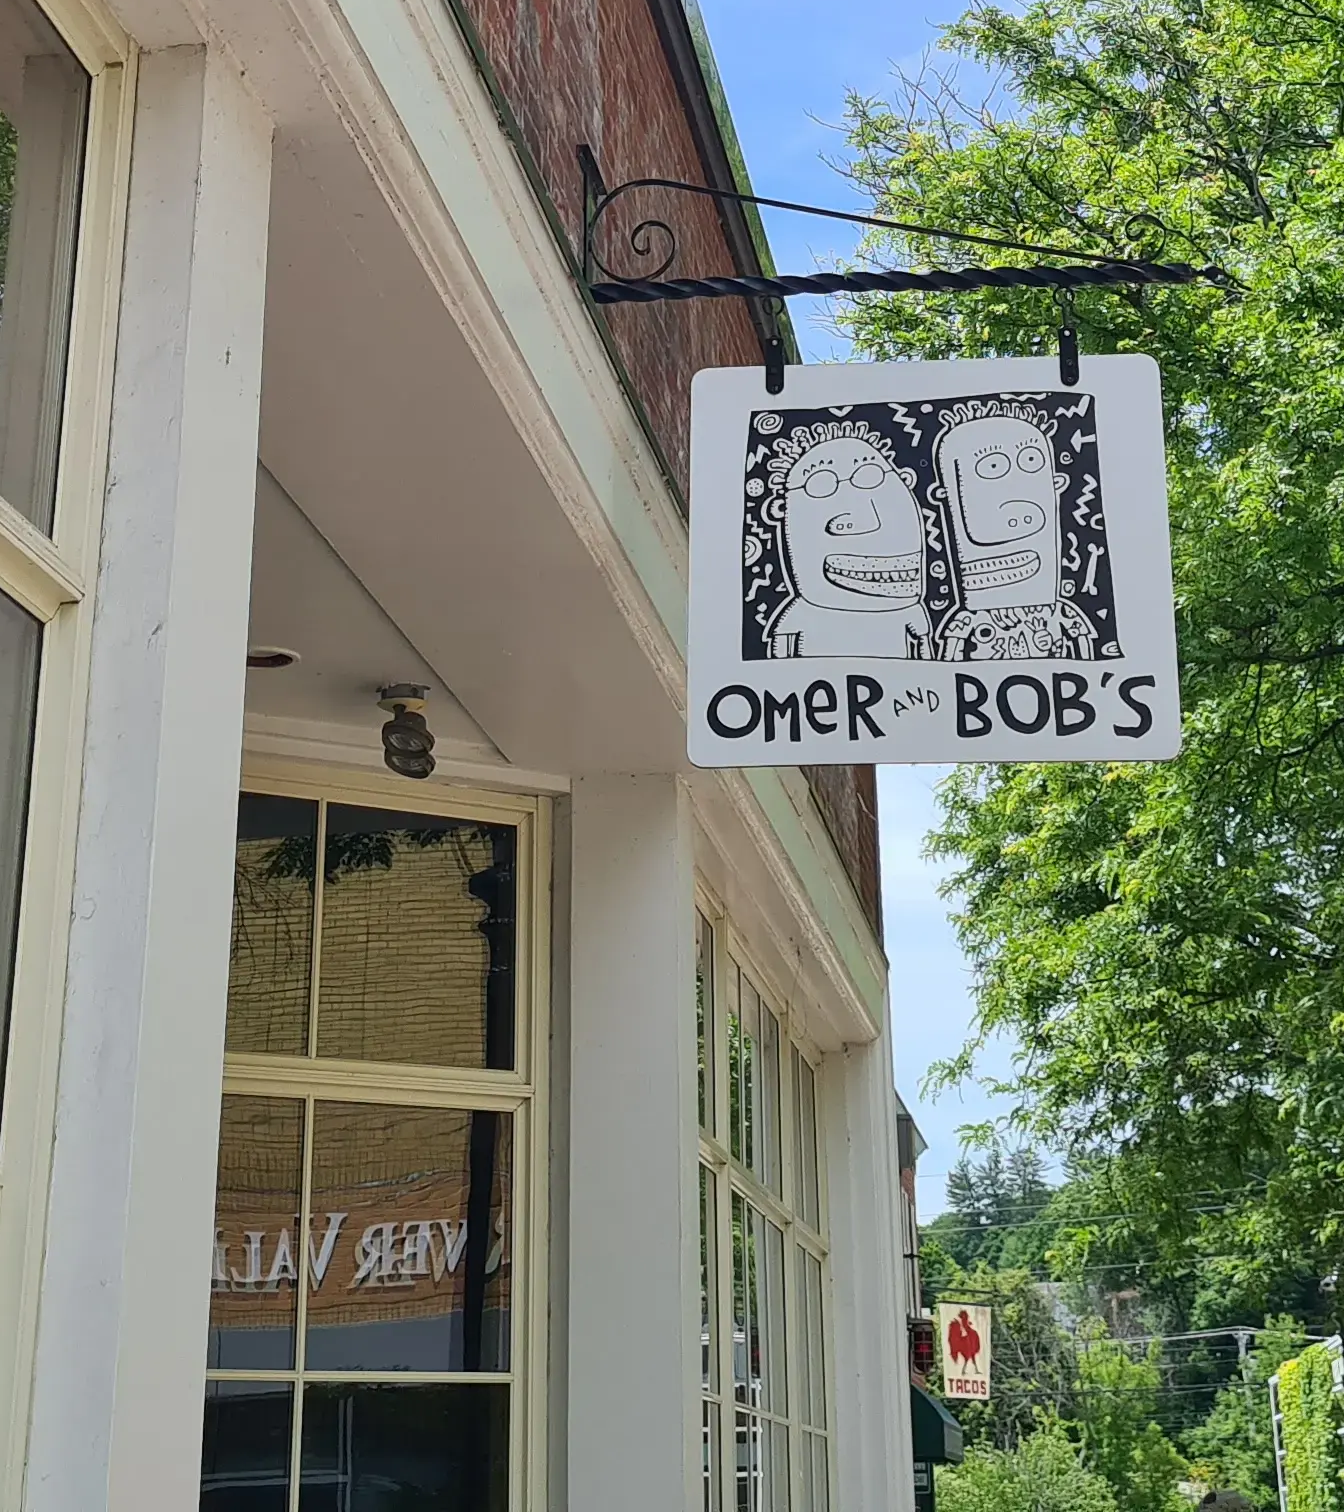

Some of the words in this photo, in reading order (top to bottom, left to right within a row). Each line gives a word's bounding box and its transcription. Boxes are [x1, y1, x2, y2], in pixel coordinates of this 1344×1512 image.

[893, 686, 941, 718] AND
[956, 672, 1156, 739] BOB'S
[947, 1378, 987, 1395] TACOS
